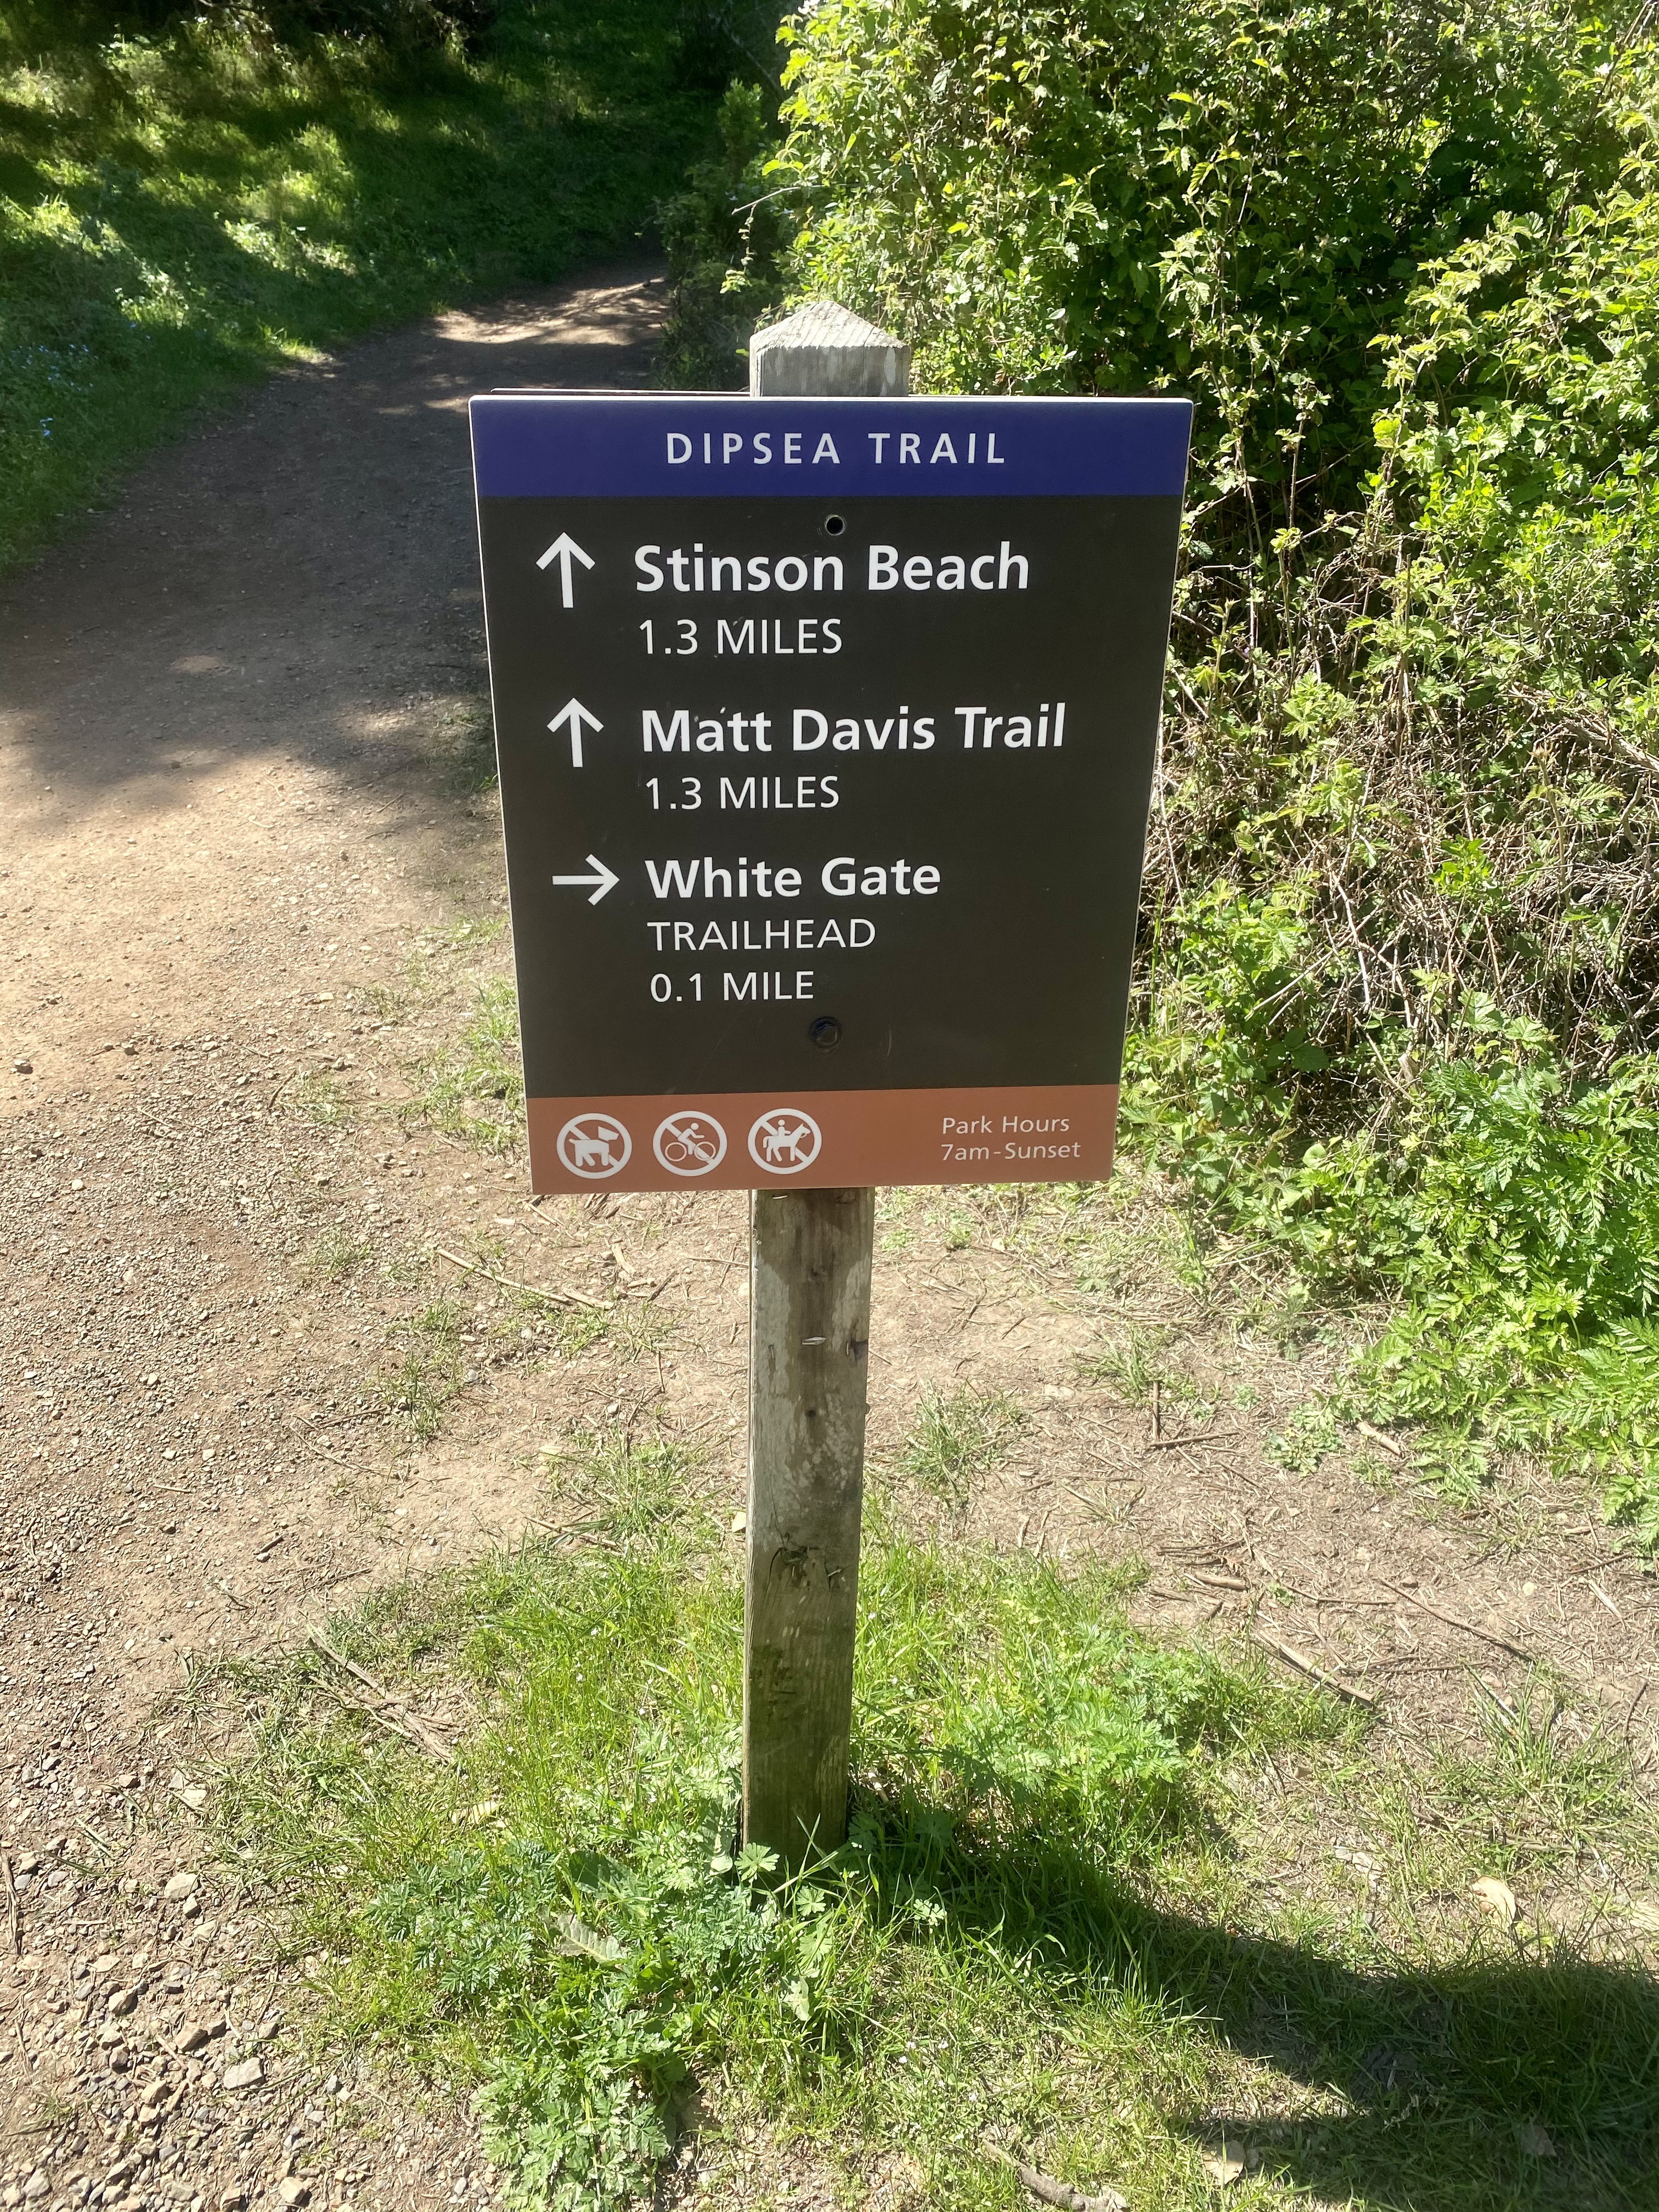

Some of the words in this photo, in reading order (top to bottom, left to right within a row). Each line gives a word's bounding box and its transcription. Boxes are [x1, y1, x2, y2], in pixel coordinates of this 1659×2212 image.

[666, 432, 841, 465] DIPSEA
[867, 432, 1005, 464] TRAIL
[634, 542, 844, 592] Stinson
[867, 540, 1029, 591] Beach
[639, 618, 698, 655] 1.3
[716, 618, 843, 654] MILES
[641, 707, 772, 753] Matt
[792, 705, 936, 752] Davis
[953, 702, 1066, 749] Trail
[645, 776, 702, 810] 1.3
[719, 775, 839, 810] MILES
[644, 856, 803, 899] White
[821, 856, 941, 896] Gate
[646, 918, 876, 951] TRAILHEAD
[650, 972, 702, 1003] 0.1
[723, 970, 814, 1001] MILE
[942, 1115, 994, 1135] Park
[1002, 1115, 1070, 1133] Hours
